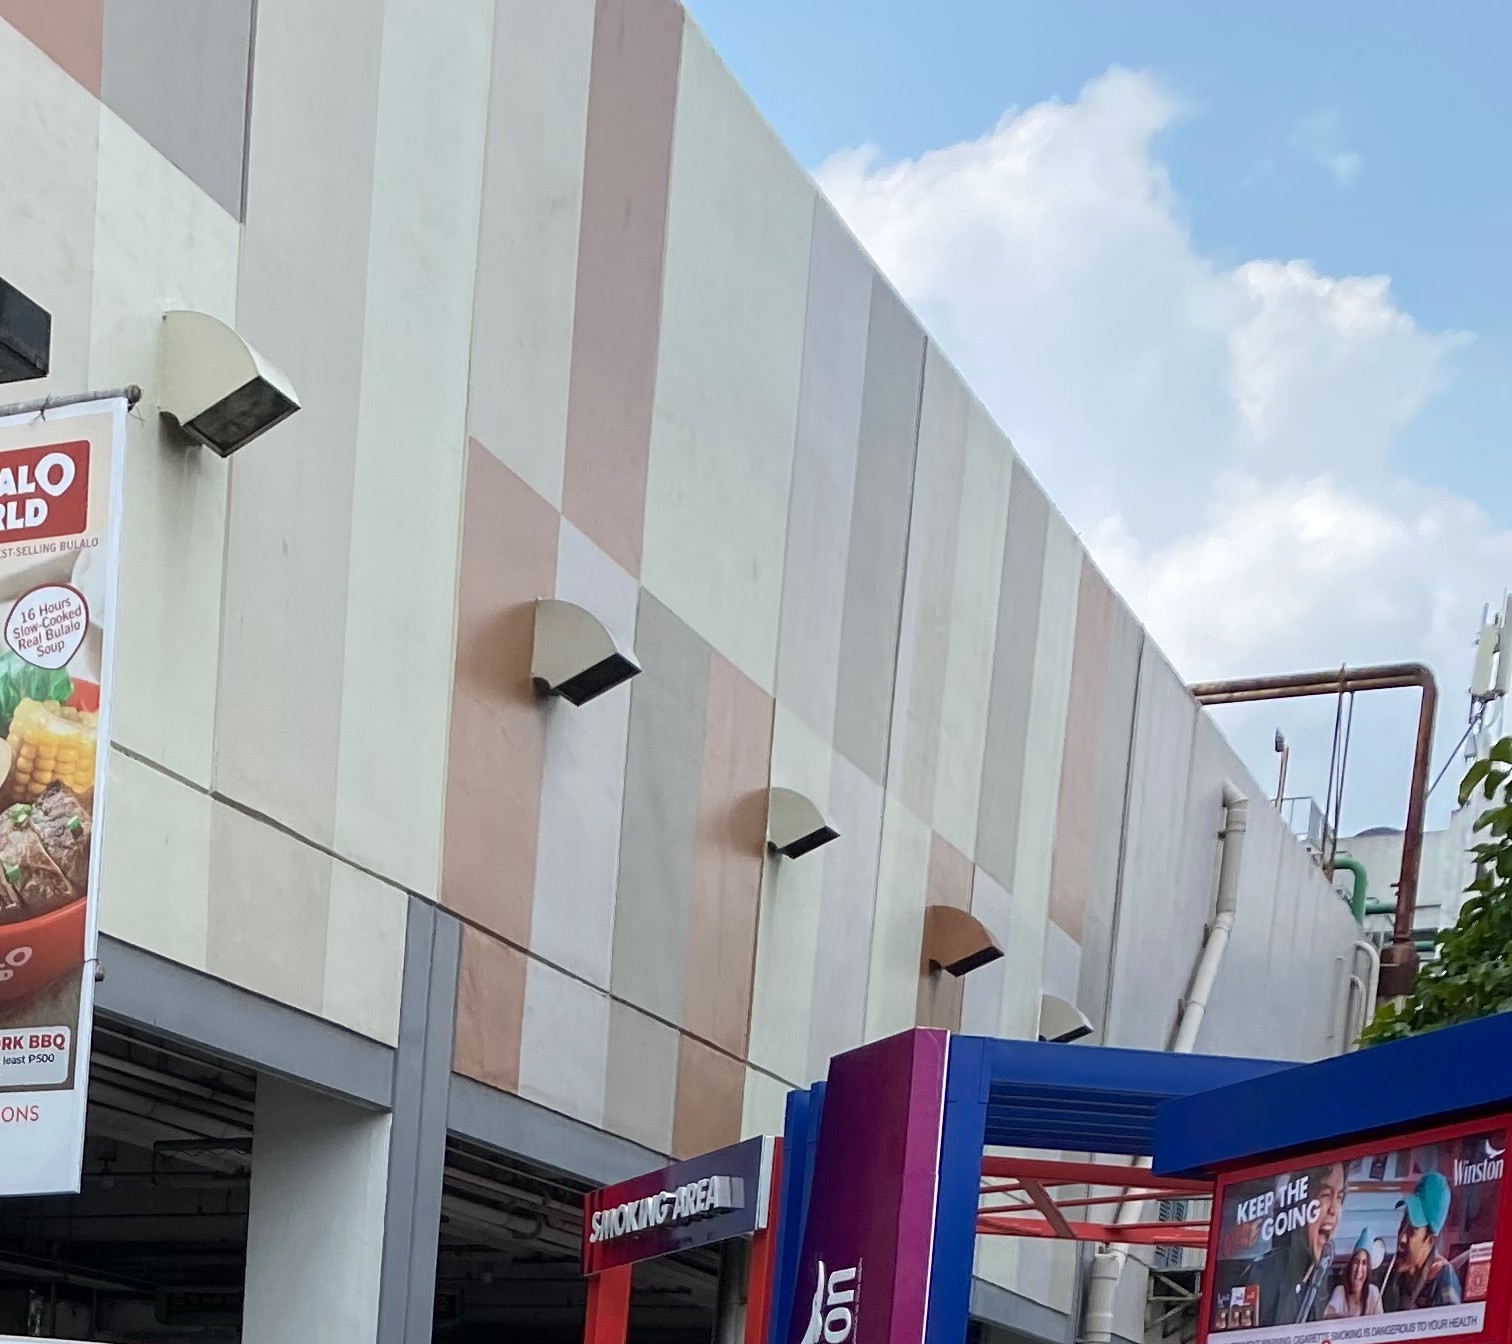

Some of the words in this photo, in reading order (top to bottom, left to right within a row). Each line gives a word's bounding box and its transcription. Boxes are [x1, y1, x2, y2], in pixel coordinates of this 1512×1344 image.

[60, 537, 99, 553] BULALO
[13, 604, 82, 640] Slow-Cooked
[21, 610, 36, 624] 16
[39, 597, 71, 617] Hours
[18, 630, 42, 651] Real
[46, 620, 81, 642] Bulalo
[36, 639, 65, 658] Soup
[28, 1033, 66, 1051] BBQ
[3, 1055, 25, 1066] least
[1454, 1158, 1504, 1187] Winston
[590, 1191, 668, 1243] SMOKING
[672, 1176, 733, 1220] AREA
[1237, 1191, 1273, 1225] KEEP
[1278, 1175, 1309, 1208] THE
[1261, 1199, 1321, 1241] GOING
[1331, 1327, 1363, 1341] SMOKING
[1371, 1321, 1417, 1337] DANGEROUS
[1417, 1321, 1427, 1332] TO
[1427, 1318, 1447, 1330] YOUR
[1448, 1315, 1478, 1328] HEALTH
